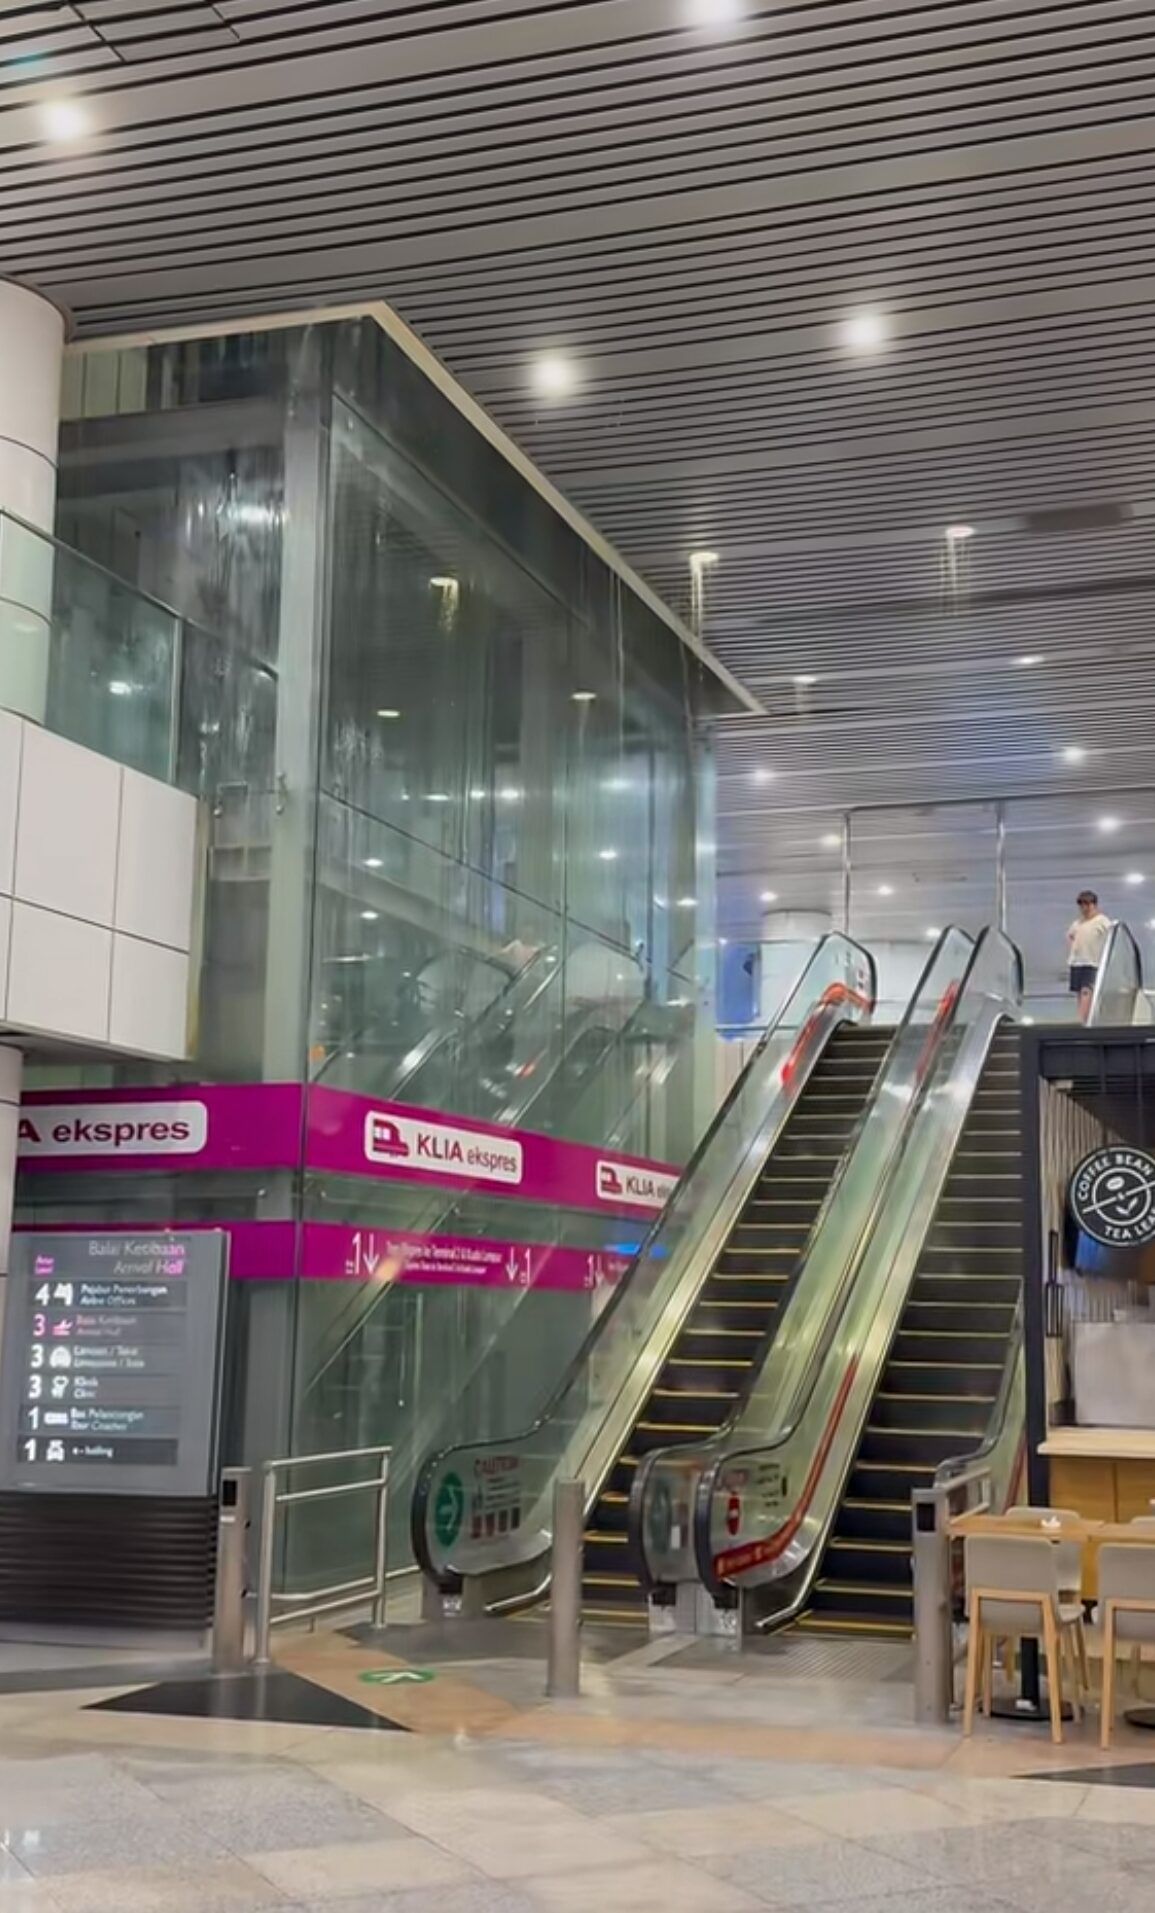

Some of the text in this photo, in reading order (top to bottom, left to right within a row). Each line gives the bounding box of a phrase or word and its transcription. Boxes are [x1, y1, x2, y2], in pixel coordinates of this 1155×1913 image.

[52, 1119, 190, 1148] ekspres
[417, 1132, 517, 1173] KLIA ekspres
[625, 1175, 656, 1198] KLIA
[1077, 1154, 1153, 1202] COFFEE BEAN
[1105, 1225, 1132, 1239] TEA
[155, 1259, 185, 1274] Hall
[35, 1282, 50, 1306] 4
[32, 1313, 46, 1337] 3
[30, 1343, 45, 1369] 3
[28, 1374, 42, 1400] 3
[28, 1406, 39, 1430] 1
[24, 1438, 36, 1461] 1
